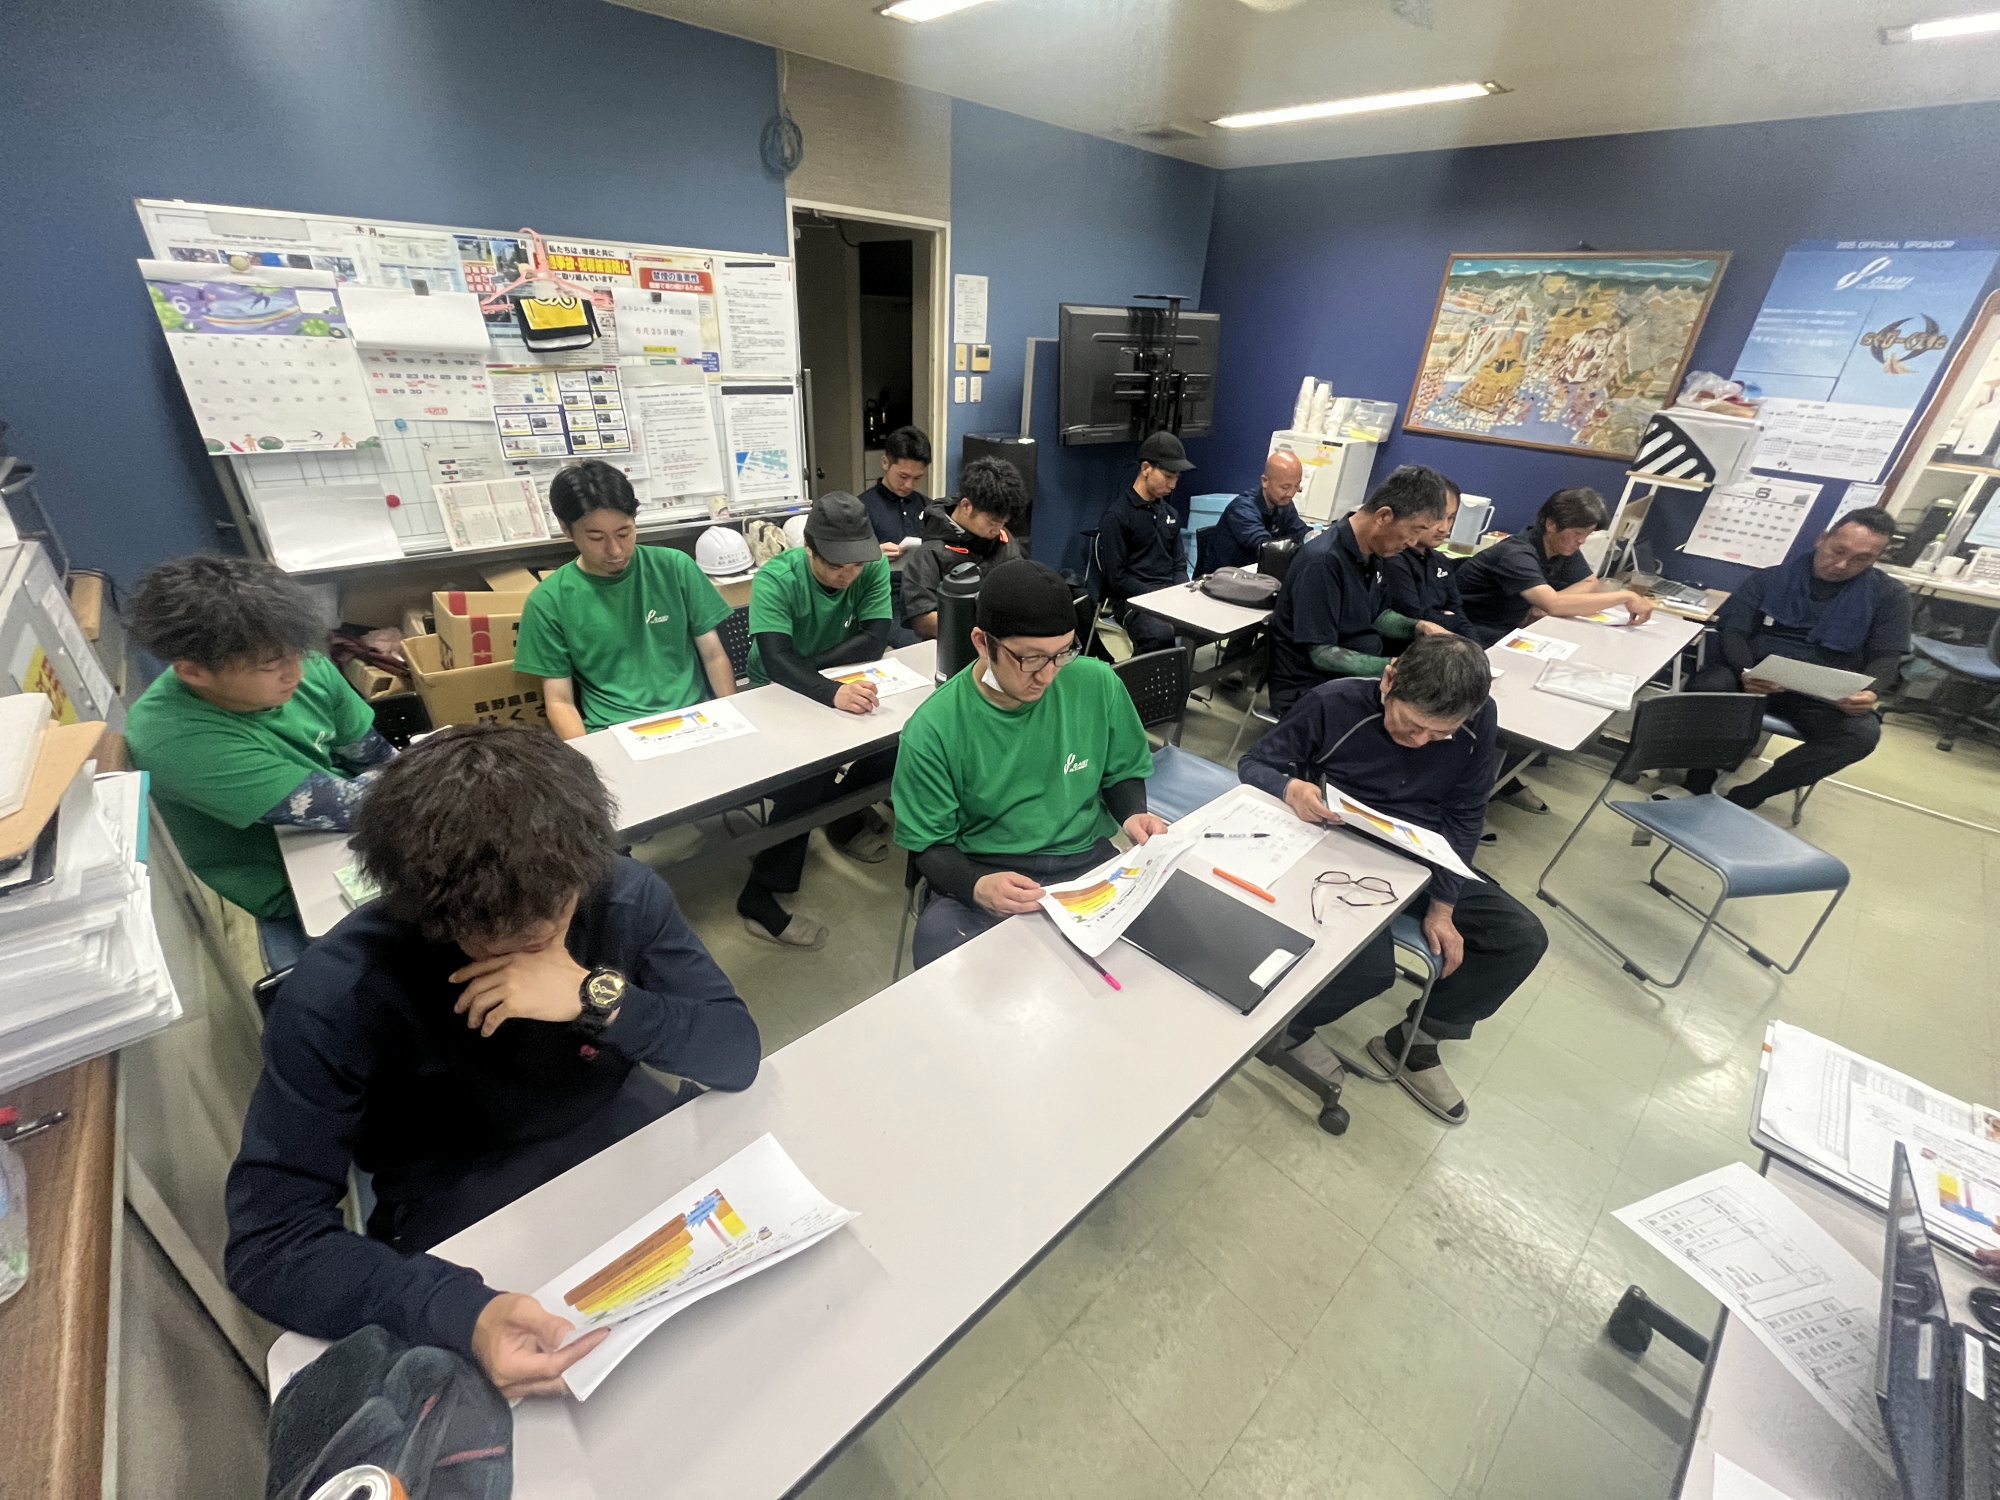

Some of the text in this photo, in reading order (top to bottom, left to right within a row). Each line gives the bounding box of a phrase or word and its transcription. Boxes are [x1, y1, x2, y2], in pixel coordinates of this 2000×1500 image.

[549, 245, 614, 257] 私たちは、地域と共に
[1857, 241, 1900, 250] OFFICIAL
[1903, 241, 1955, 249] SPONSOR
[1755, 487, 1772, 499] 6
